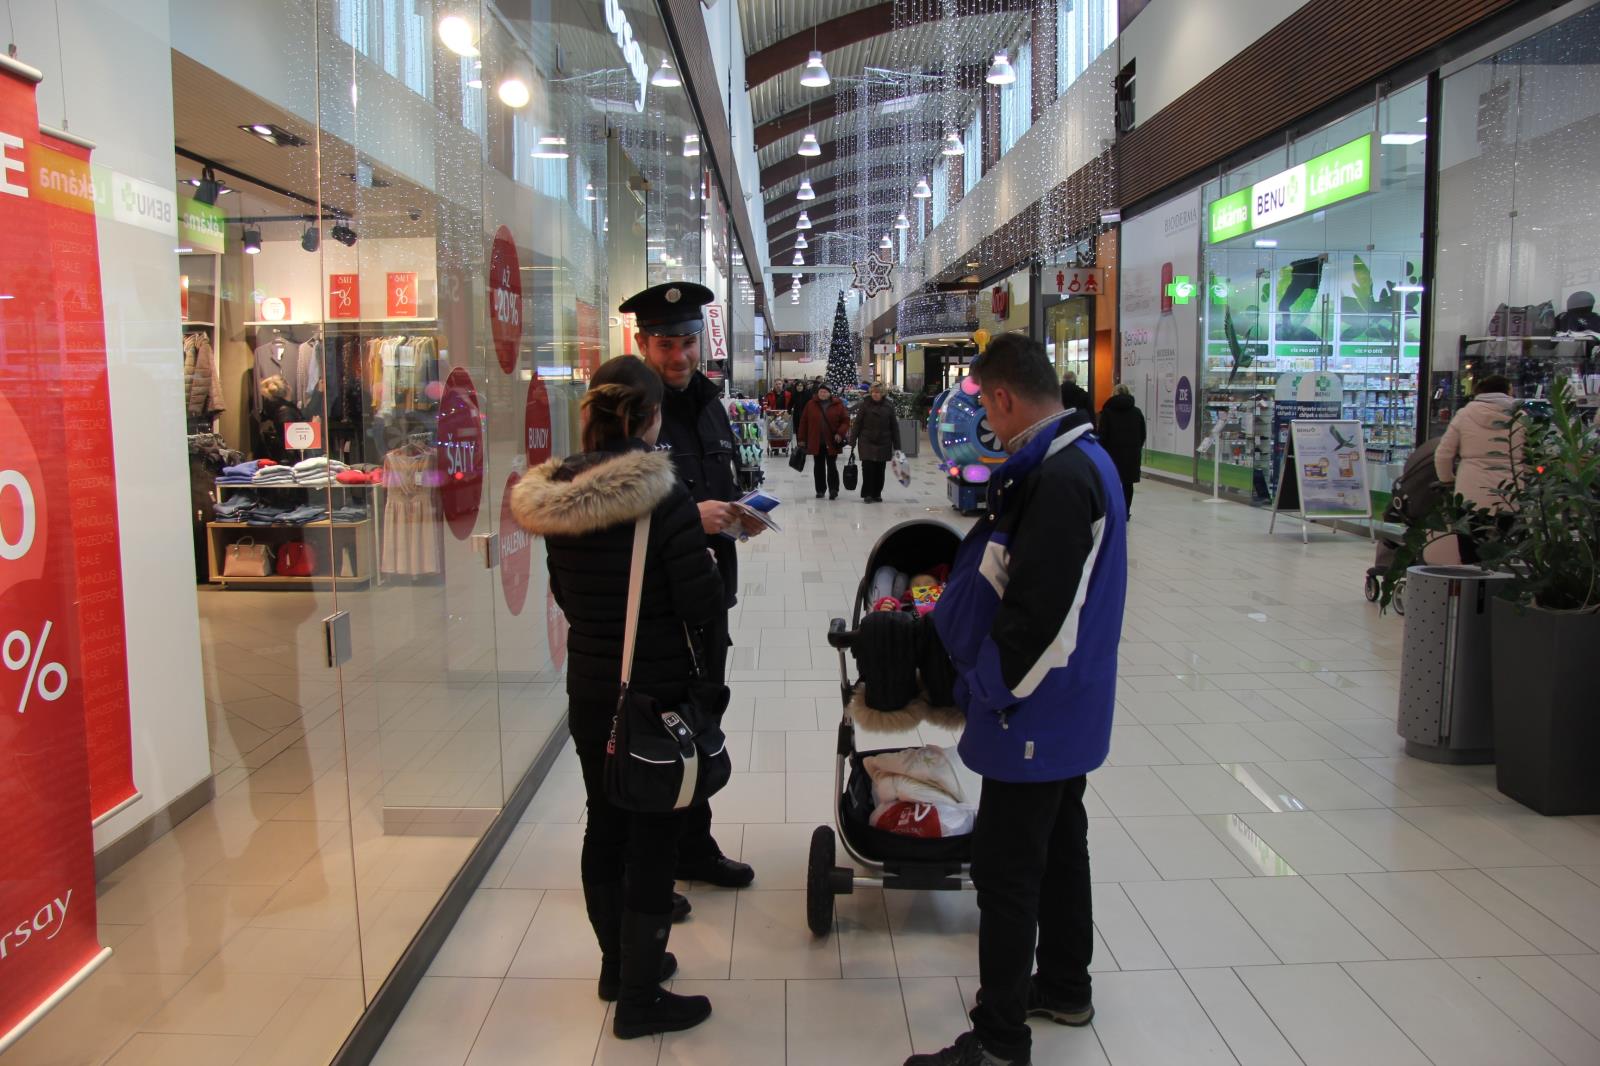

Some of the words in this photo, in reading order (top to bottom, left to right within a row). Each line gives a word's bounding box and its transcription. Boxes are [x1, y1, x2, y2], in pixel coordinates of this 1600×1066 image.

[1256, 186, 1286, 216] BENU
[1309, 160, 1363, 197] Lékárna
[709, 308, 726, 357] SLEVA
[447, 433, 475, 475] ŠATY
[528, 426, 549, 450] BUNDY
[2, 620, 68, 714] %
[0, 888, 73, 962] rsay
